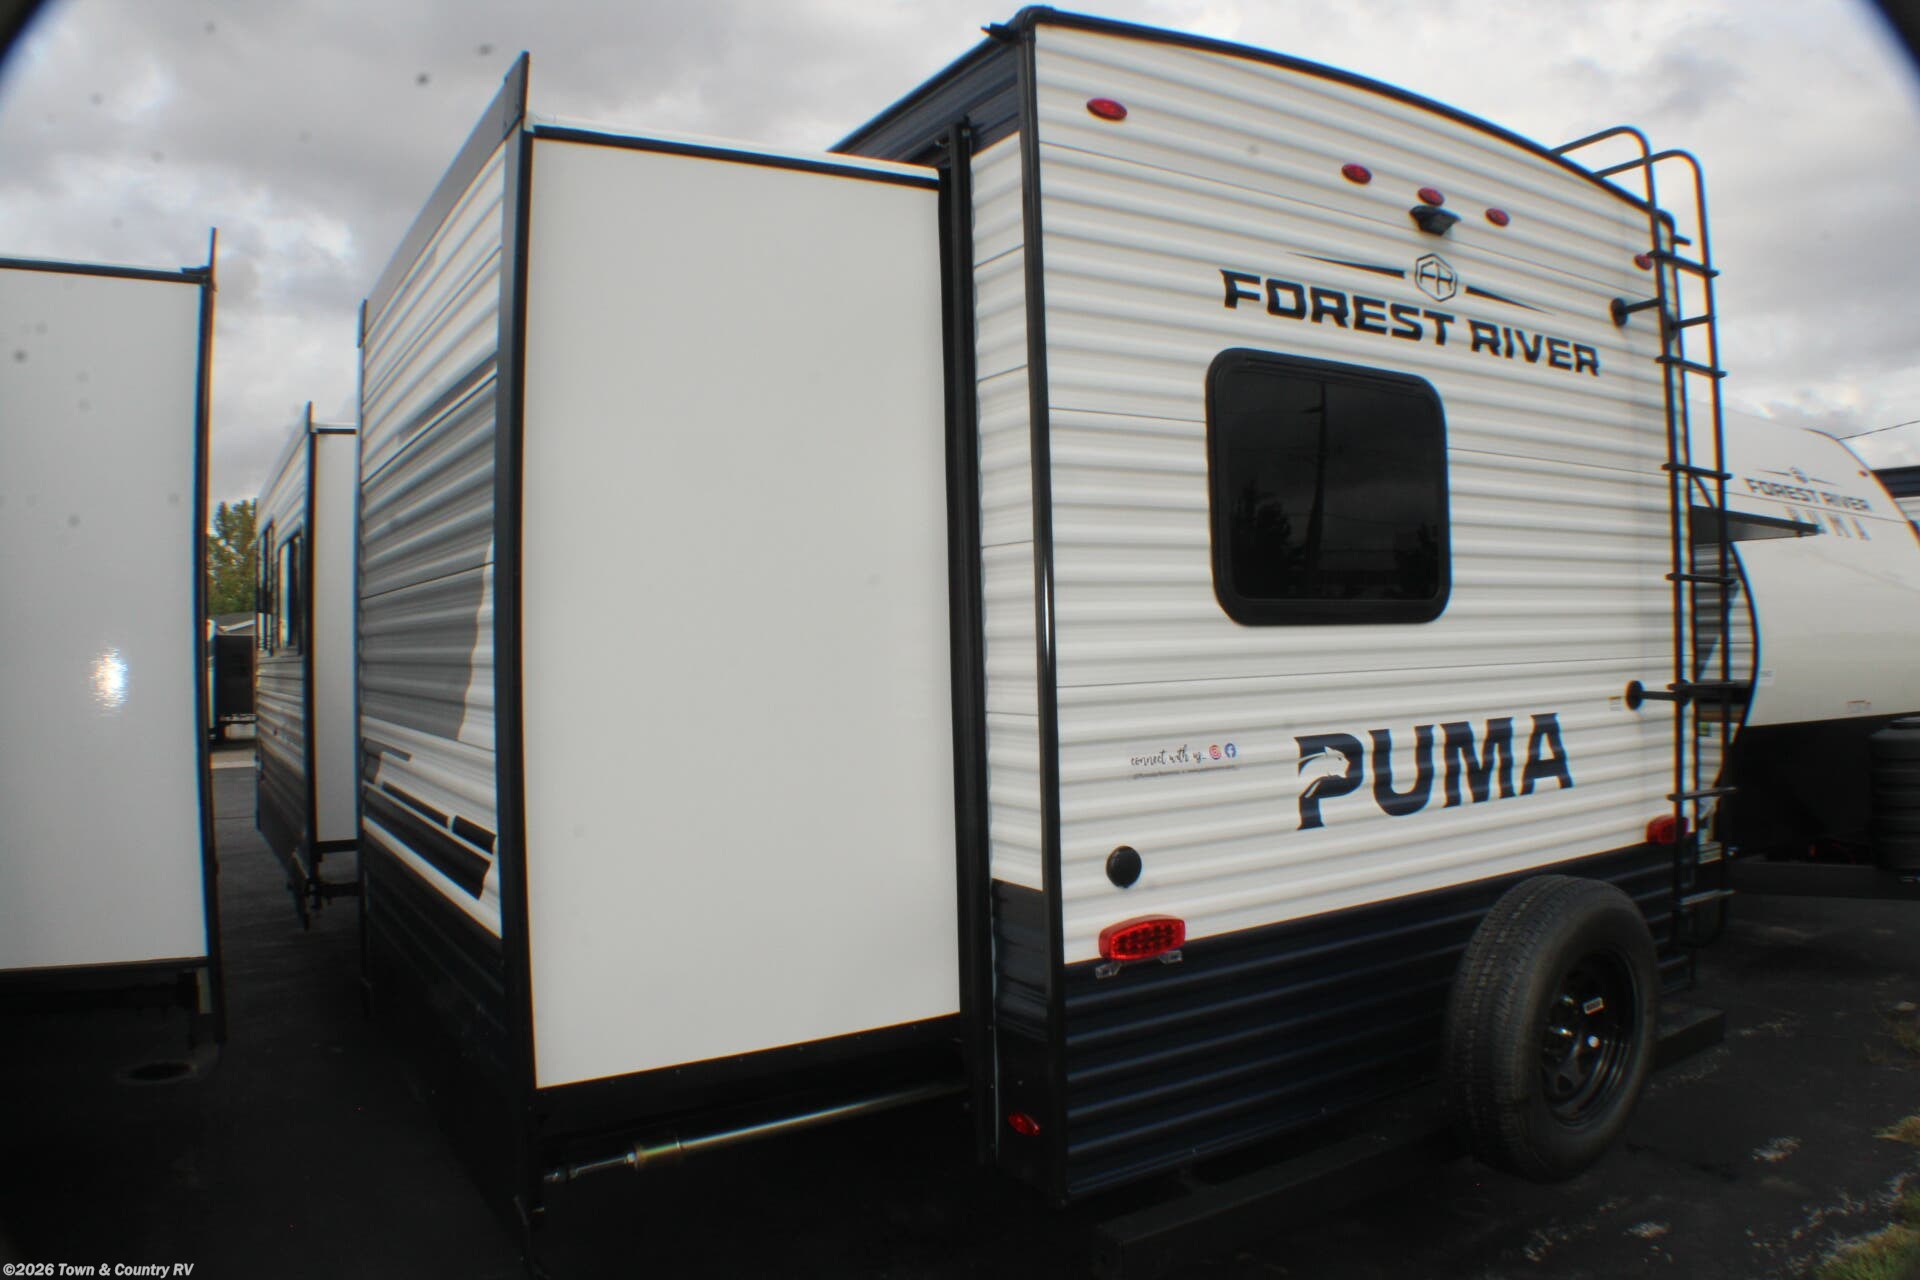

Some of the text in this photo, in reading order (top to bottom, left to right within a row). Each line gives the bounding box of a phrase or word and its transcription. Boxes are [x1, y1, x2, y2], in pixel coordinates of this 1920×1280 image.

[1219, 269, 1600, 378] FOREST RIVER
[1294, 712, 1575, 831] PUMA
